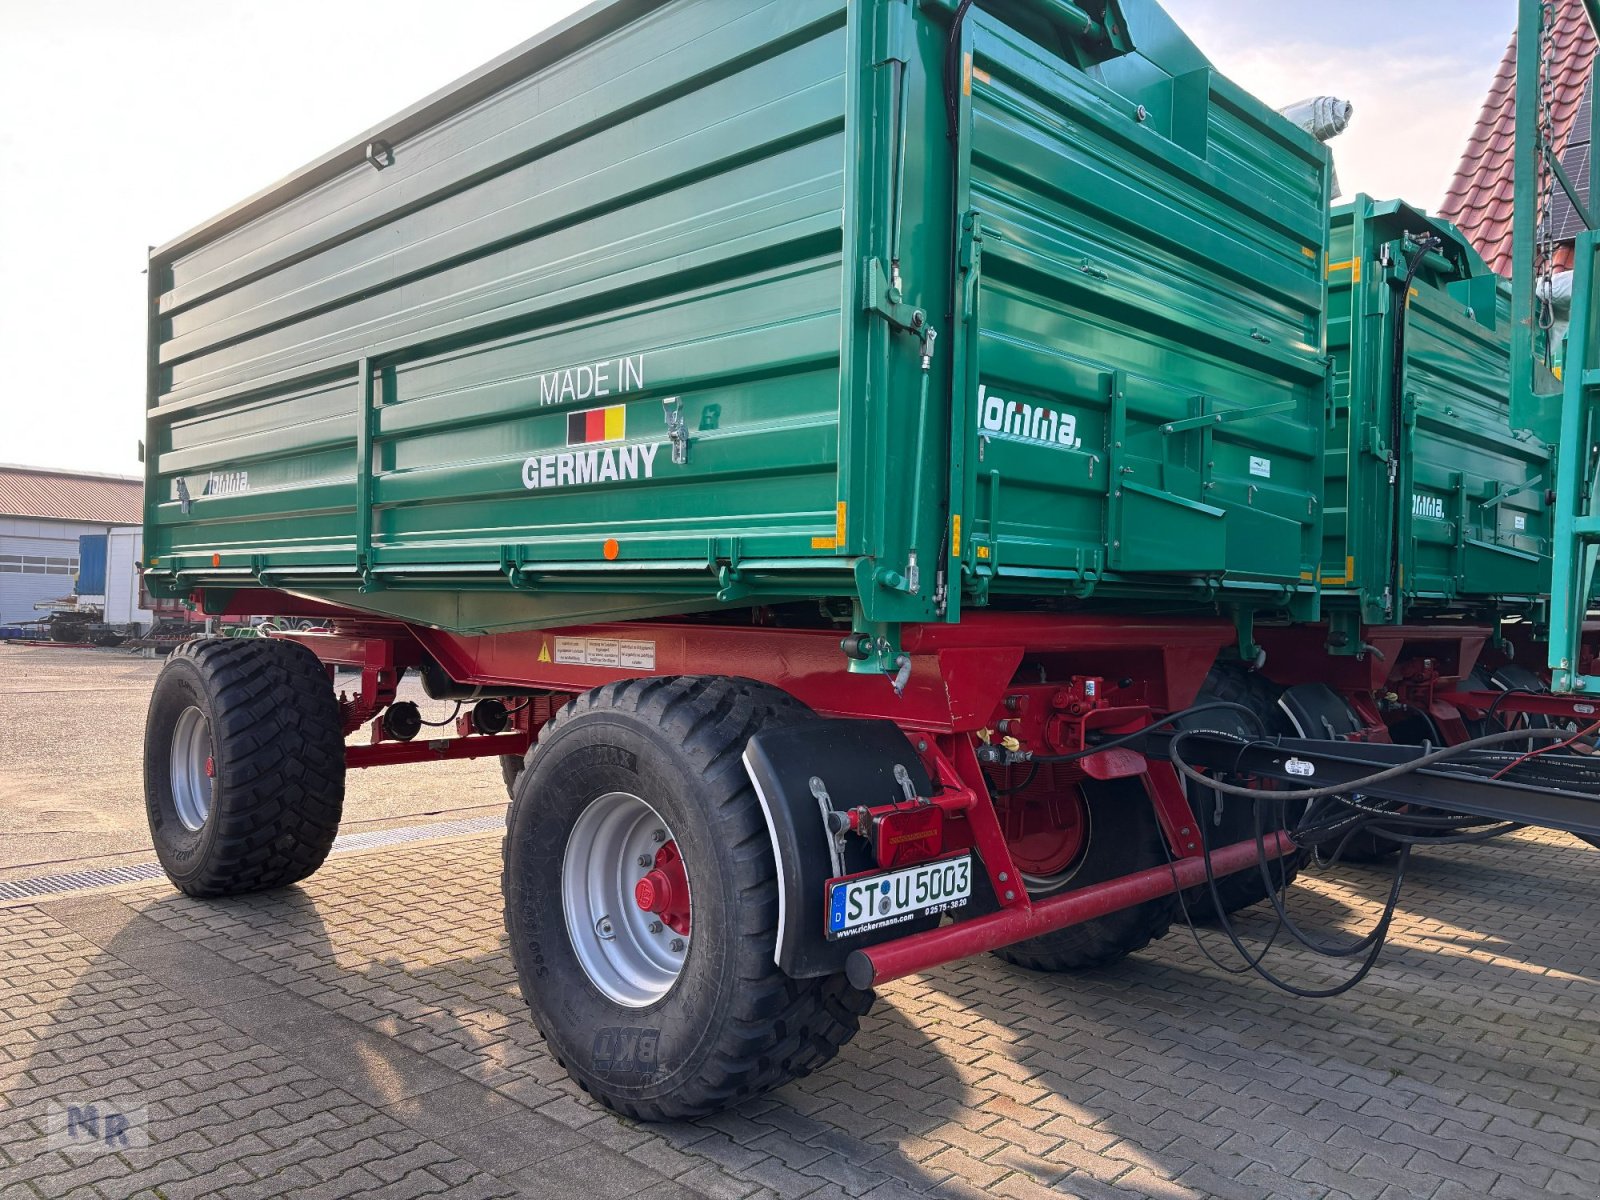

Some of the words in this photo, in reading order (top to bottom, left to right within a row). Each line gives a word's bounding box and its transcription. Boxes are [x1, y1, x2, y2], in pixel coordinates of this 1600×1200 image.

[540, 361, 610, 406] MADE
[618, 354, 644, 392] IN
[521, 442, 660, 489] GERMANY
[835, 912, 842, 923] D
[847, 882, 880, 920] ST
[896, 875, 911, 909] U
[916, 861, 969, 903] 5003
[836, 913, 914, 939] www.rickermann.com
